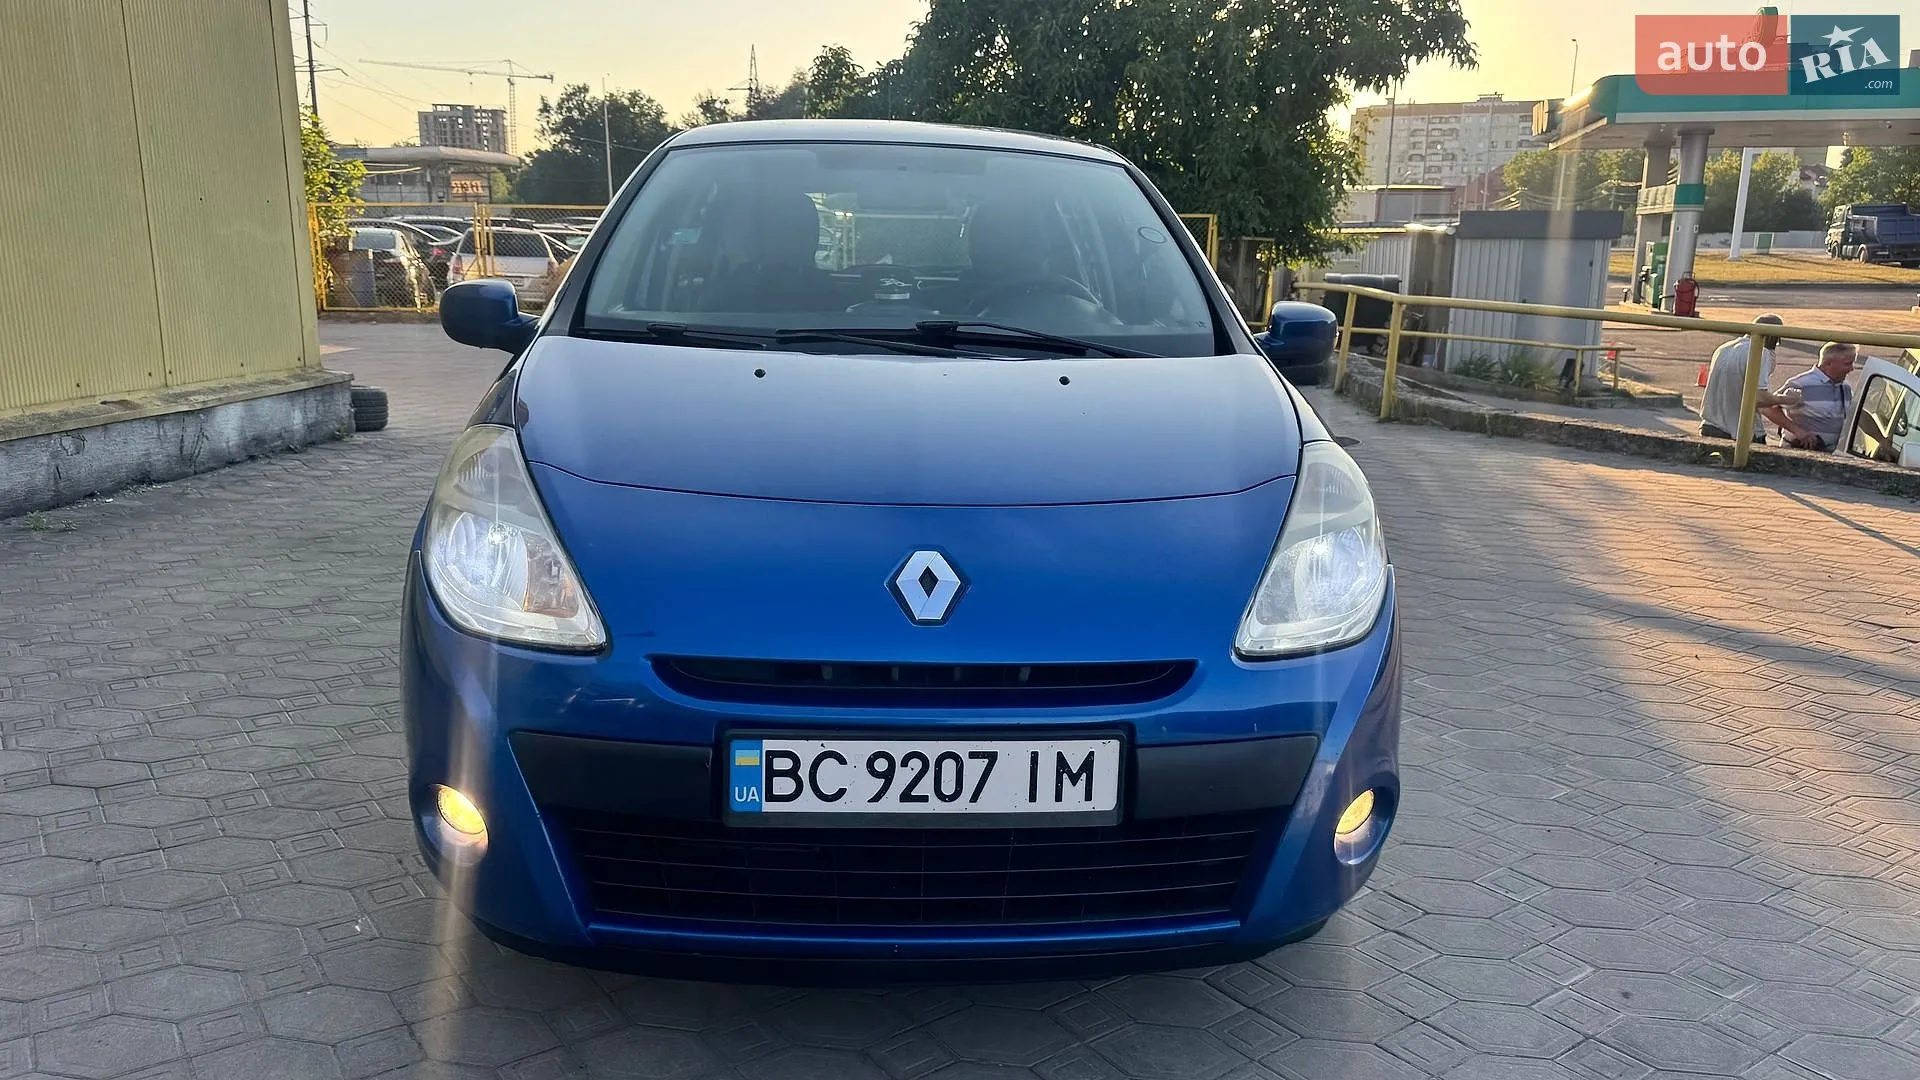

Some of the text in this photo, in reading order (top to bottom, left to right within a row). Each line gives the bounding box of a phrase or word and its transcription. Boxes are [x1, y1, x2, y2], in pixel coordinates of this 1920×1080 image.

[765, 750, 1095, 803] BC 9207 IM
[734, 786, 760, 802] UA
